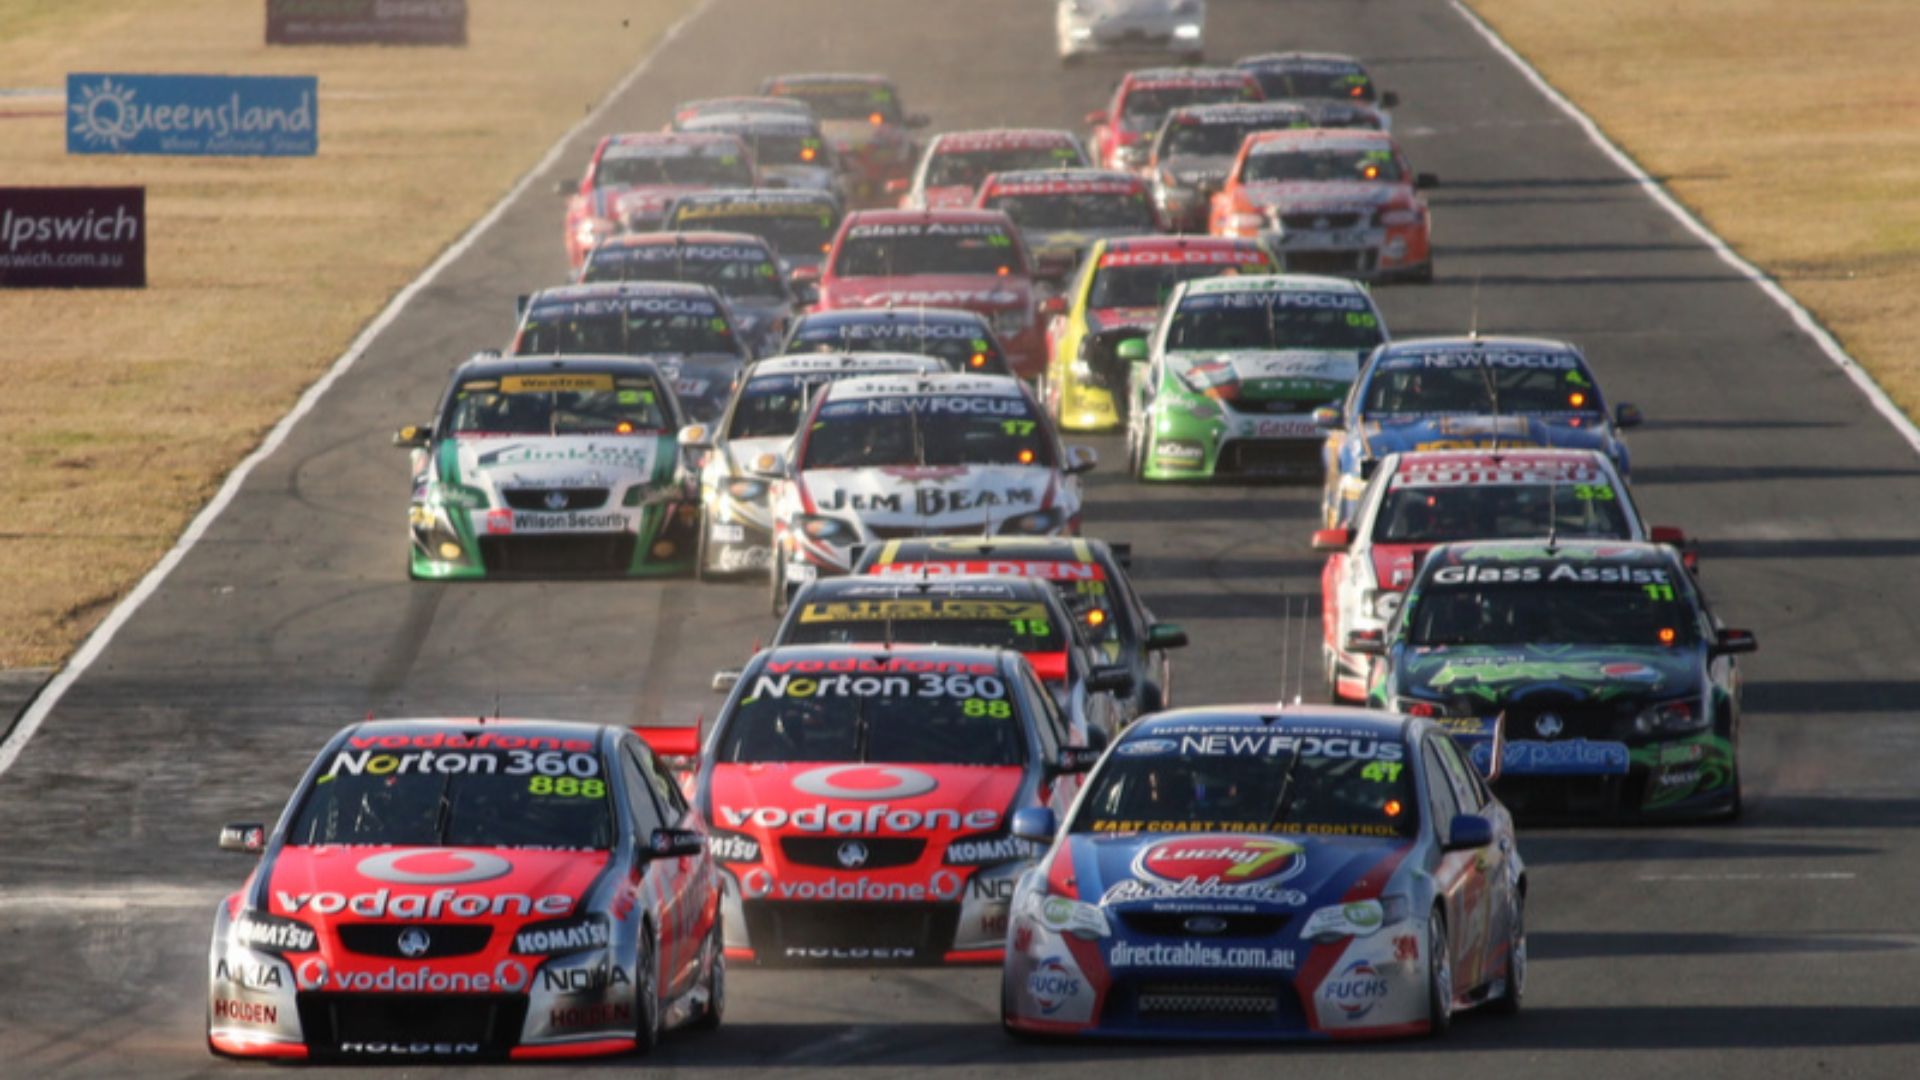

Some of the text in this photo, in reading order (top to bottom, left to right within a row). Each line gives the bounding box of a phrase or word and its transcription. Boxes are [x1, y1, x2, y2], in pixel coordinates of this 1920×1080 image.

[88, 90, 311, 140] Queensland
[1, 206, 137, 251] Ipswich
[1106, 251, 1261, 265] HOLDEN
[1001, 419, 1036, 436] 17
[880, 562, 1095, 579] HOLDEN
[1433, 564, 1541, 584] Glass
[1548, 563, 1669, 584] Assist
[1643, 584, 1674, 601] 11
[1010, 619, 1050, 637] 15
[766, 657, 996, 675] vodafone
[752, 674, 1004, 700] Norton 360
[963, 699, 1012, 719] 88
[349, 732, 594, 751] vodafone
[1180, 735, 1403, 761] NEW FOCUS
[328, 750, 599, 777] Norton 360
[1359, 761, 1404, 783] 47
[527, 775, 607, 799] 888
[719, 803, 1000, 832] vodafone
[1093, 820, 1146, 832] EAST
[1148, 820, 1215, 832] COAST
[1306, 823, 1400, 836] CONTROL
[779, 877, 925, 901] vodafone
[276, 888, 576, 920] vodafone
[1110, 942, 1295, 970] directcables.com.au
[216, 958, 283, 988] NIA
[334, 966, 491, 992] vodafone
[1324, 977, 1390, 1001] FUCHS
[214, 1000, 277, 1025] HOLDEN
[550, 1004, 630, 1027] HOLDEN
